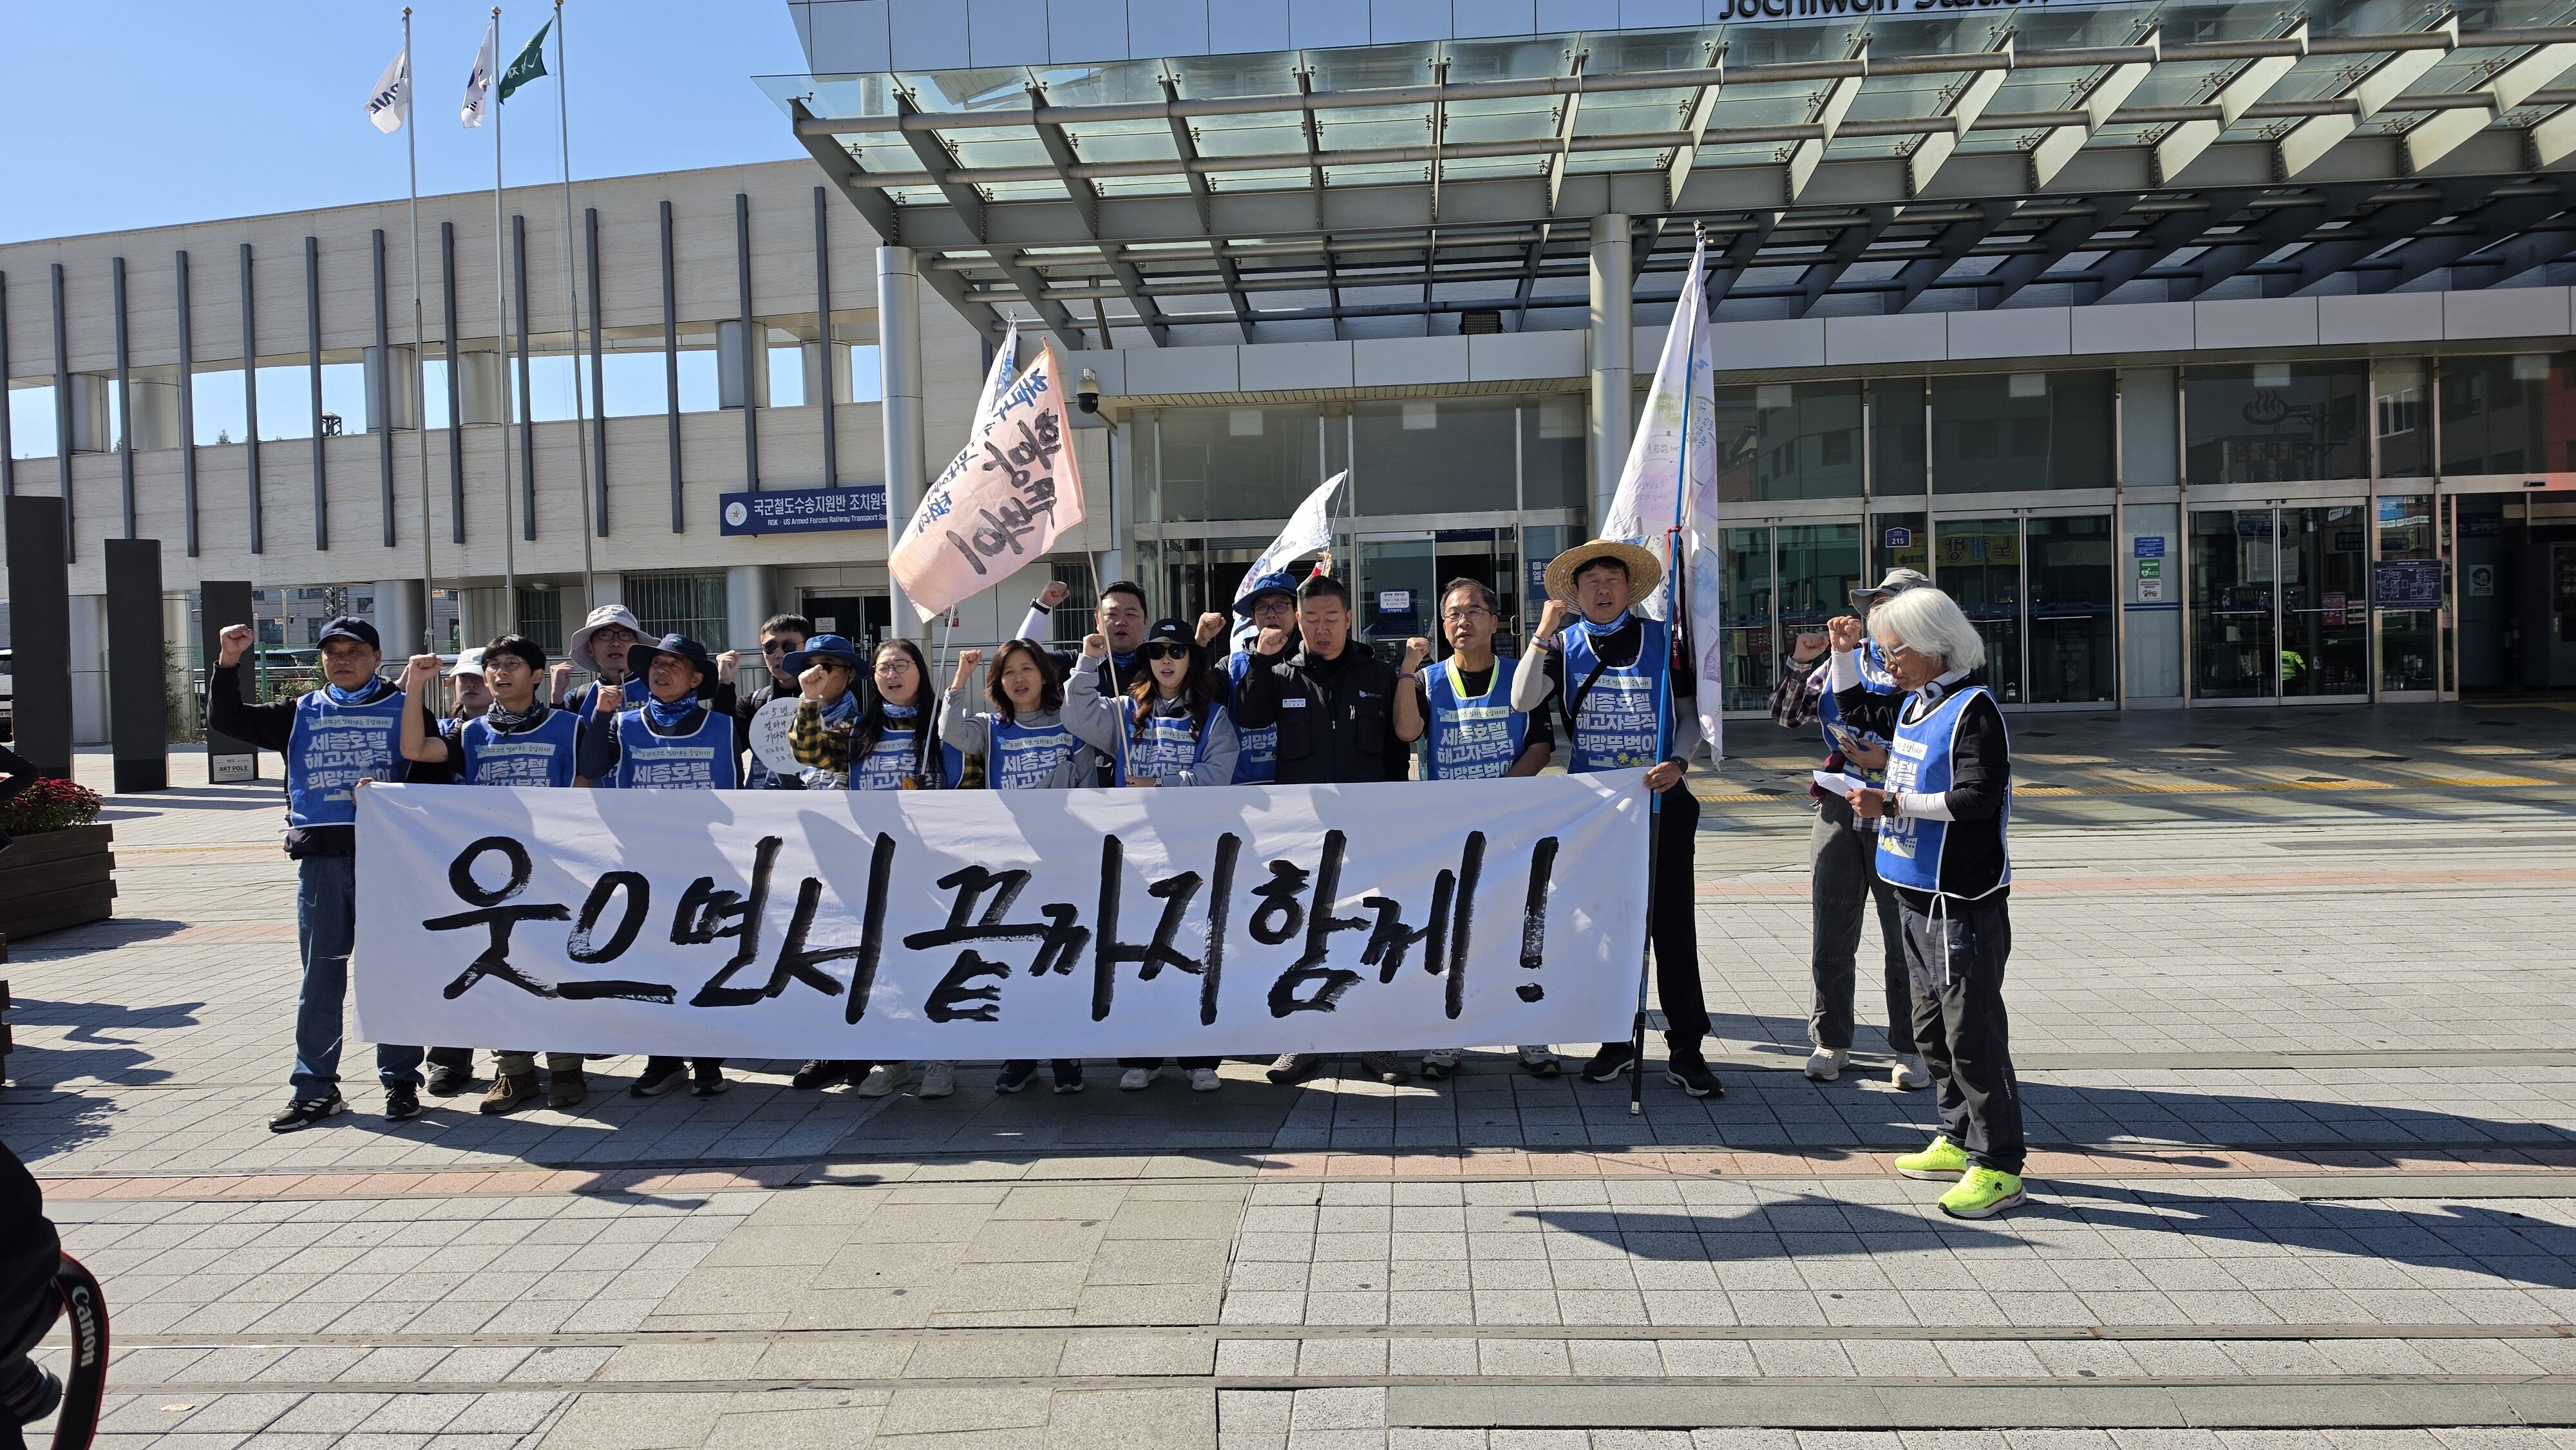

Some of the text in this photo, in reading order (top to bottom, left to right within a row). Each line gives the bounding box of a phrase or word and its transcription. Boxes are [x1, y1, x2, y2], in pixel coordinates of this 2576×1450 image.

[754, 494, 846, 516] 국군철도수송지원반
[810, 516, 828, 525] Forces
[829, 515, 850, 524] Railway
[851, 514, 878, 523] Transport
[1577, 713, 1657, 731] 해고자복직
[308, 731, 388, 752] 세종호텔
[1440, 722, 1509, 746] 세종호텔
[1578, 734, 1657, 753] 희망뚜벅이
[304, 749, 393, 769] 해고자복직
[861, 752, 917, 772] 세종호
[1129, 742, 1196, 764] 세종호텔
[1437, 740, 1515, 764] 해고자복직
[307, 768, 392, 791] 희망뚜이
[473, 757, 548, 782] 세종호텔
[632, 761, 711, 783] 세종호텔
[422, 829, 1559, 1026] 웃으면서 끝까지 함께!
[71, 1286, 96, 1368] Canon
